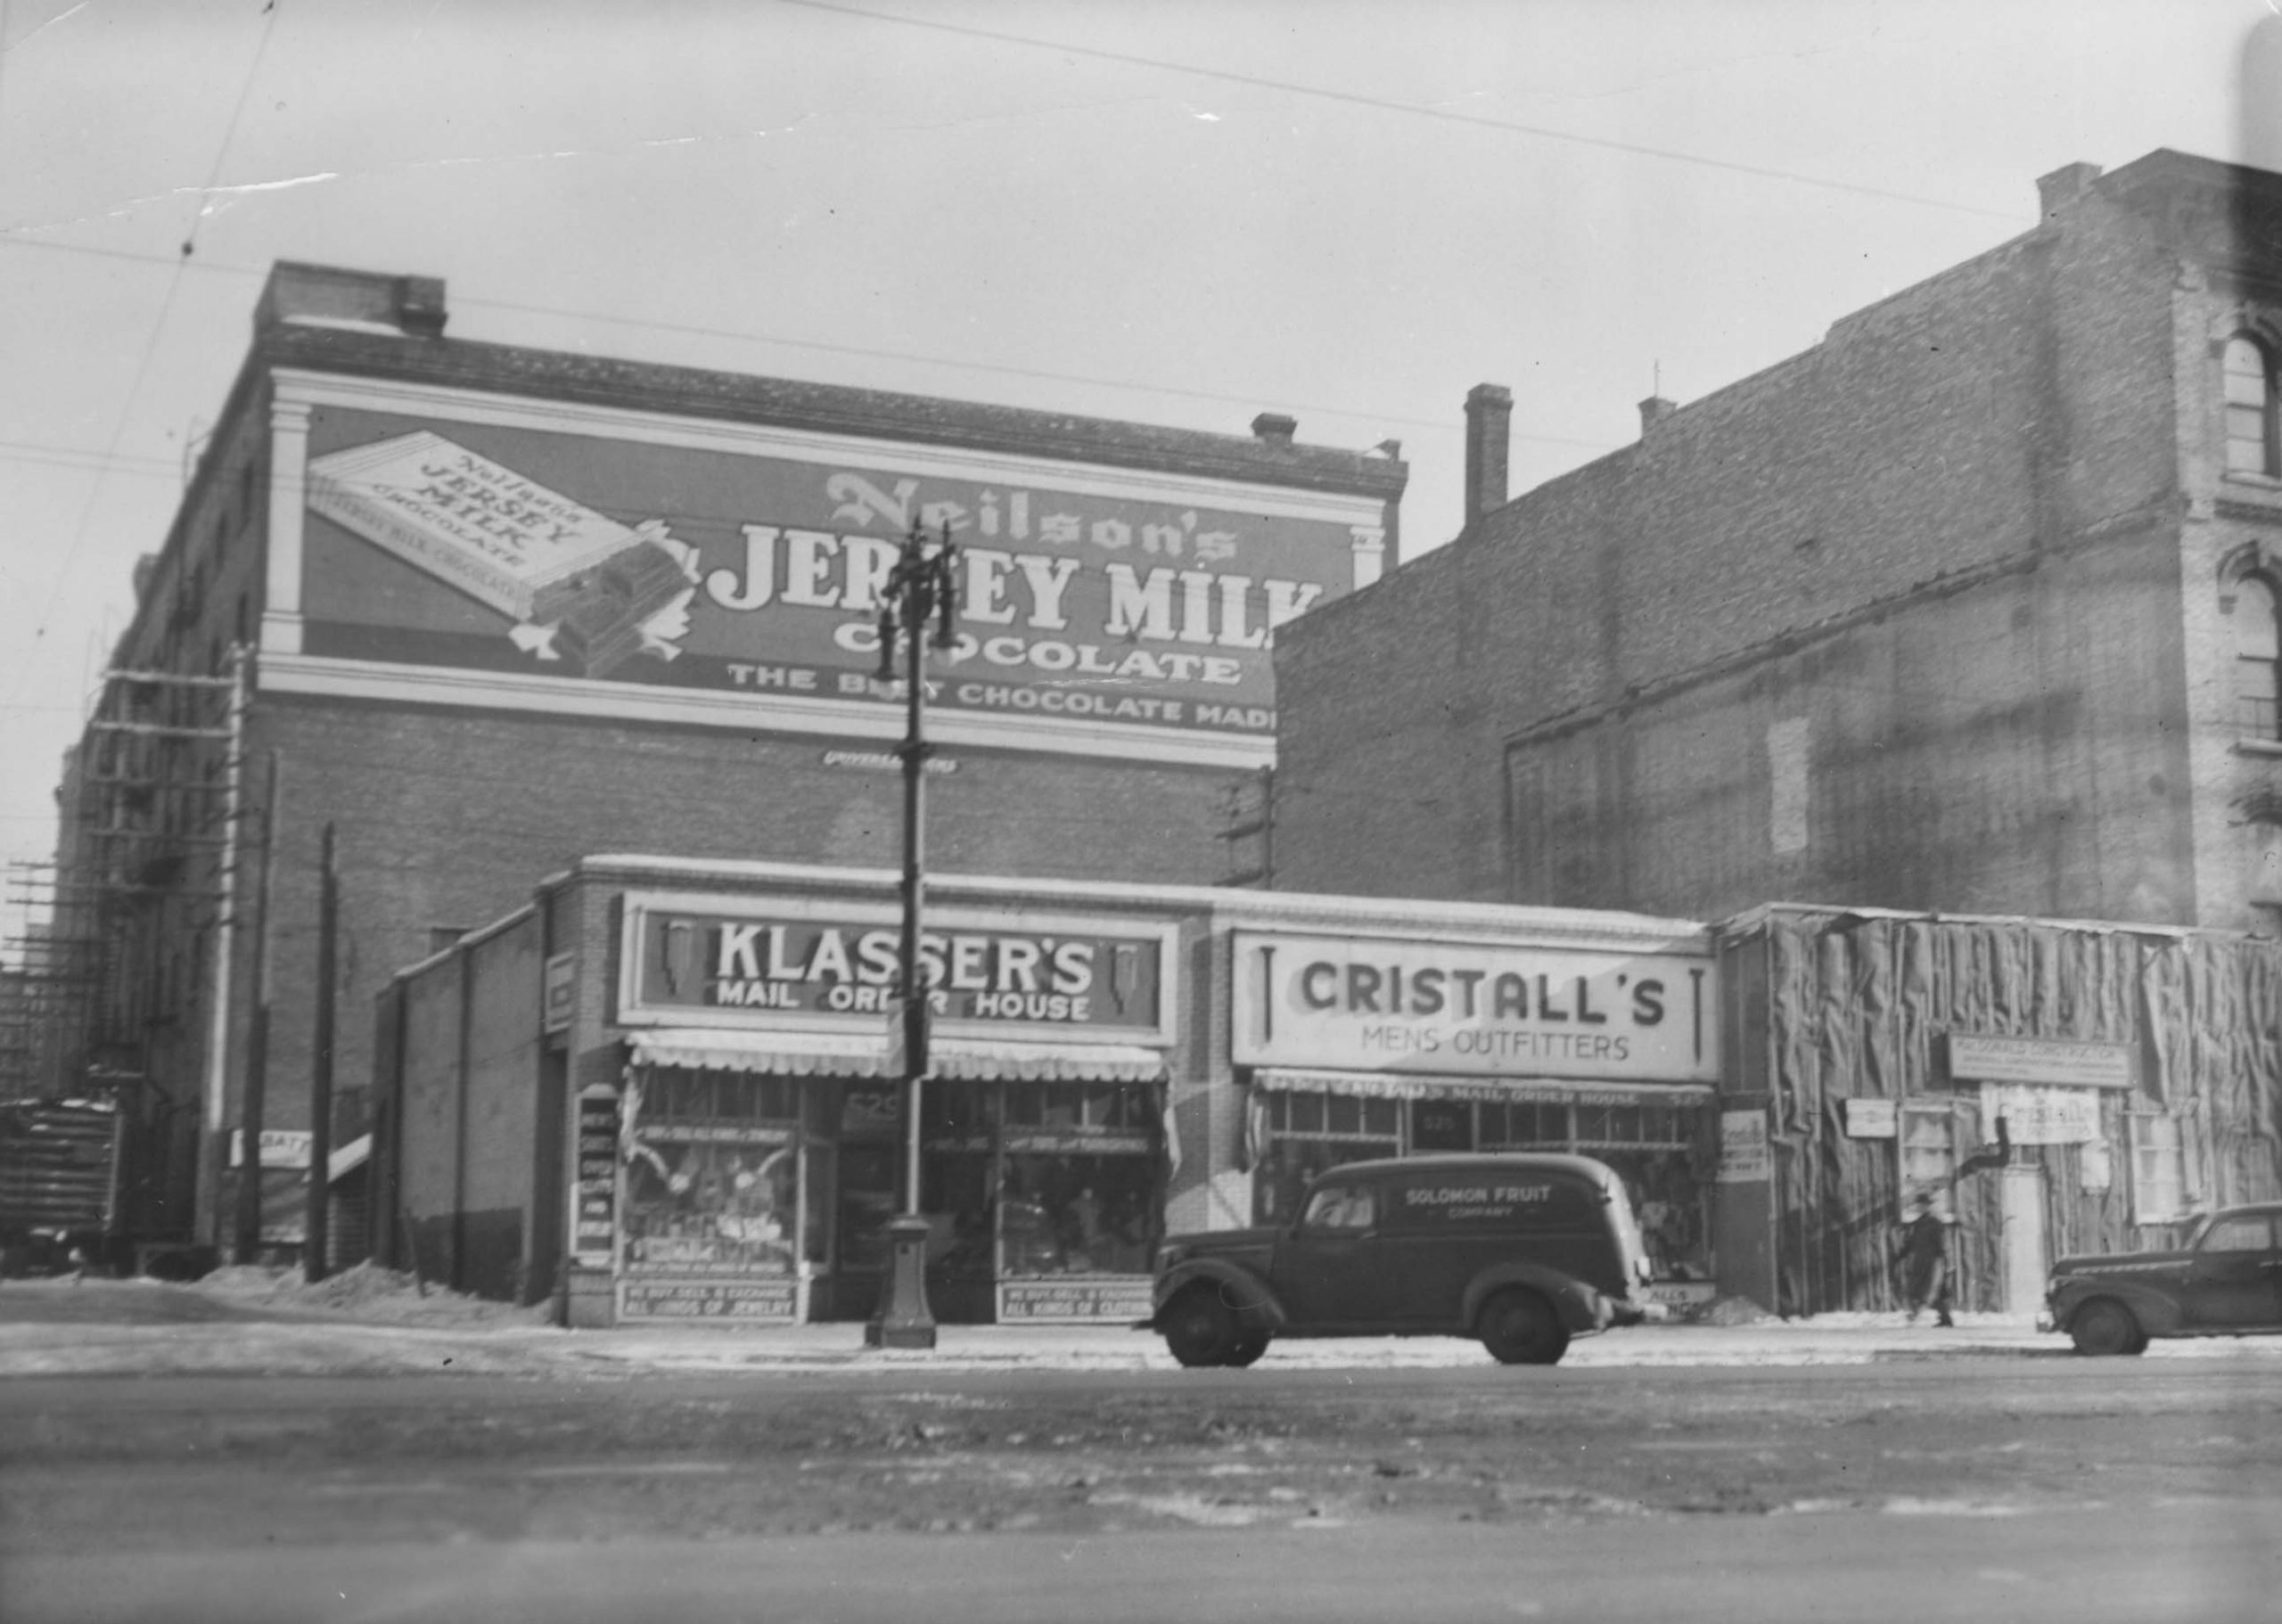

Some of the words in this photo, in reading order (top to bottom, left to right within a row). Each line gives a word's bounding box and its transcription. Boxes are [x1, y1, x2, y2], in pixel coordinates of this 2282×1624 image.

[373, 482, 527, 567] CHOCOLATE
[415, 484, 535, 550] MILK
[420, 462, 584, 545] JERSEY
[826, 471, 1238, 562] Neilson's
[704, 522, 1079, 632] JEREY
[1104, 562, 1324, 652] MILK
[726, 662, 818, 693] THE
[838, 672, 945, 701] BT
[957, 683, 1183, 724] CHOCOLATE
[717, 920, 1094, 996] KLASSER'S
[718, 980, 800, 1009] MAIL
[829, 985, 948, 1015] ORR
[976, 991, 1090, 1021] HOUSE
[1302, 960, 1665, 1027] CRISTALL'S
[1362, 1027, 1440, 1053] MENS
[1453, 1030, 1630, 1061] OUTFITTERS
[1452, 1087, 1505, 1102] MAIL
[1510, 1090, 1575, 1104] ORDER
[1580, 1093, 1640, 1106] HOUSE
[1406, 1187, 1488, 1206] SOLOMON
[1494, 1185, 1552, 1203] FRUIT
[1448, 1206, 1514, 1220] COMPANY
